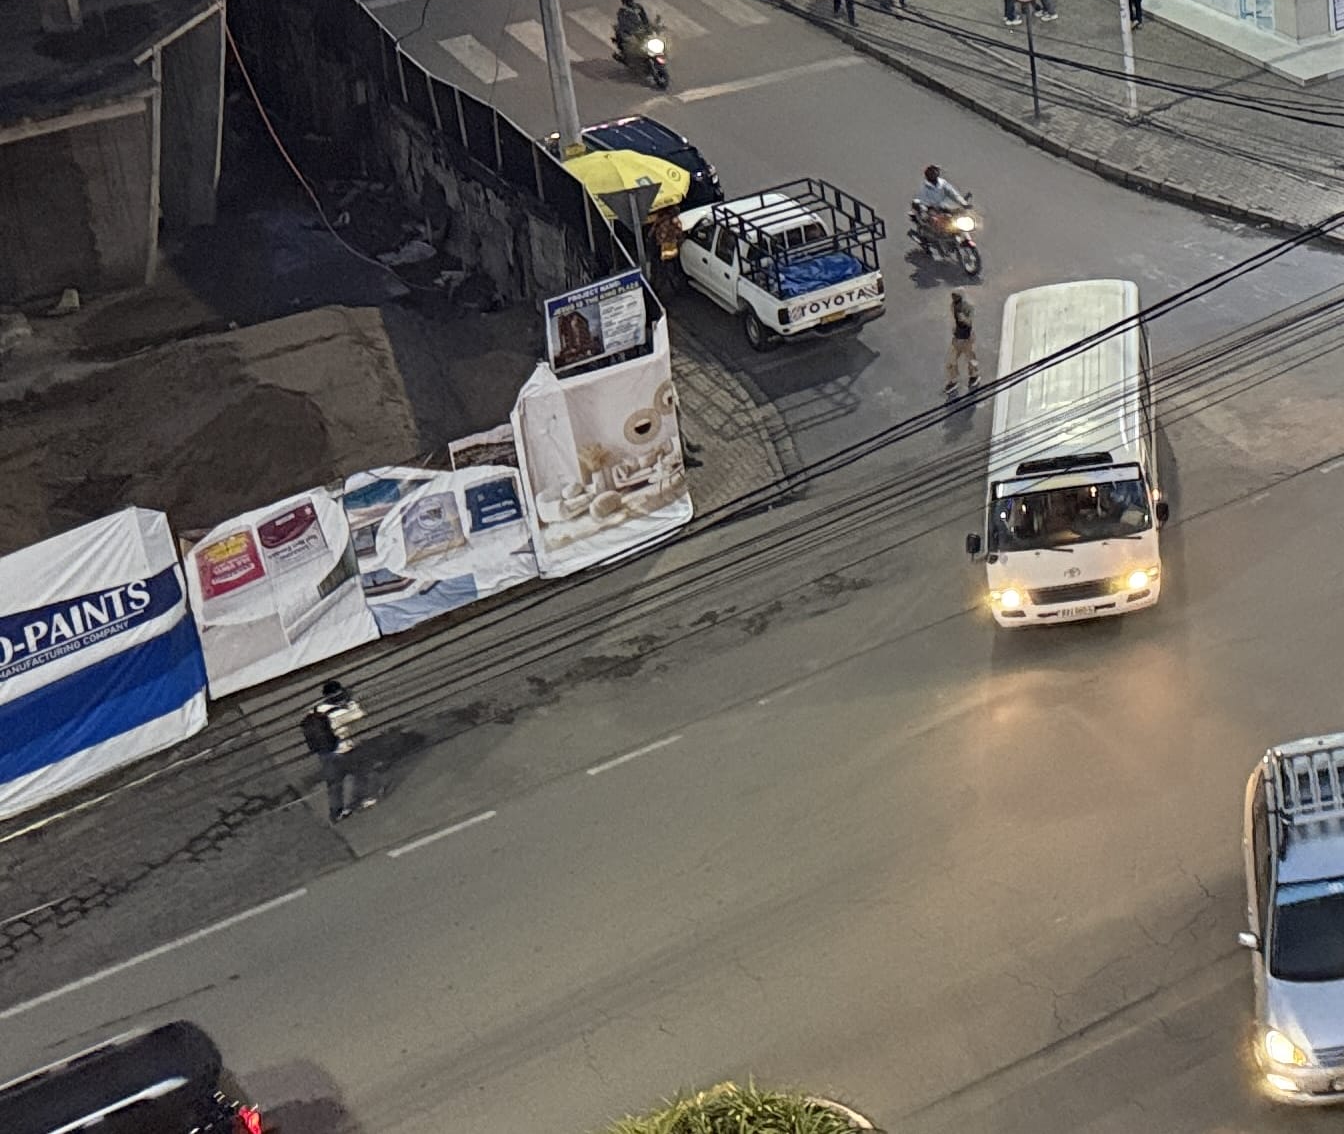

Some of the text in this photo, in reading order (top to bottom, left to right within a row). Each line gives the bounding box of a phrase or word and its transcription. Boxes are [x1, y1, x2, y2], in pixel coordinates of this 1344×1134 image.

[567, 288, 599, 303] PROJECT
[800, 289, 867, 317] TOYOTA
[82, 621, 130, 645] COMPANY
